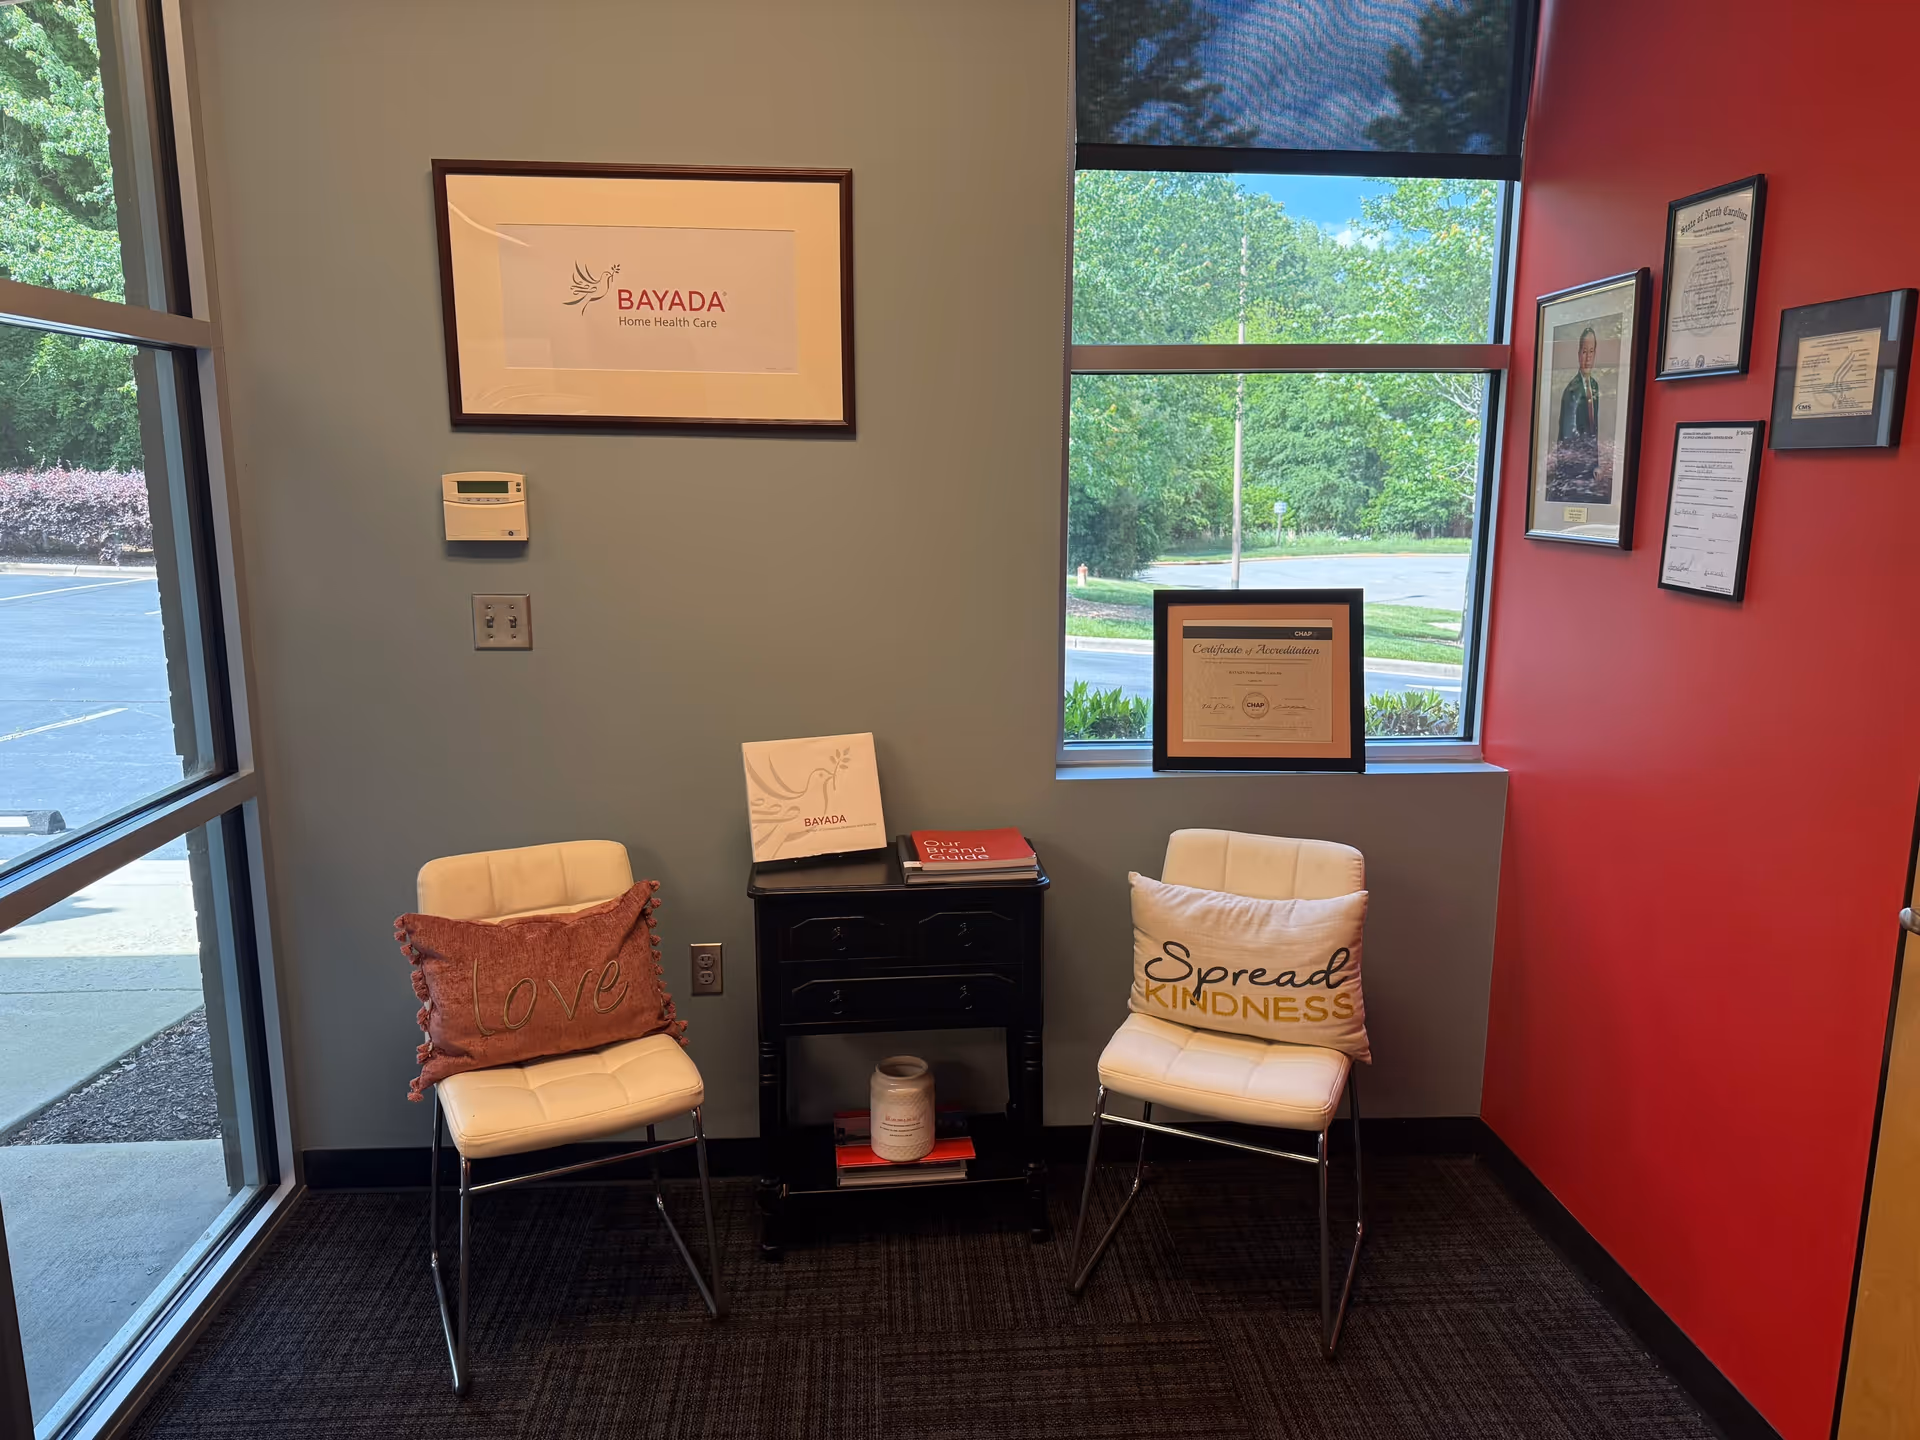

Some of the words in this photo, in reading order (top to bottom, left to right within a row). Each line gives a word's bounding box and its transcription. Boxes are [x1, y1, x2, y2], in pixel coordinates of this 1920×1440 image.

[1680, 219, 1696, 236] State
[1704, 206, 1722, 220] North
[1723, 205, 1748, 221] Carolina
[617, 289, 725, 313] BAYADA
[618, 316, 651, 327] Home
[654, 317, 690, 328] Health
[693, 318, 717, 329] Care
[1192, 643, 1243, 657] Certificate
[1245, 647, 1254, 656] of
[1256, 643, 1321, 656] Accreditation
[803, 814, 848, 827] BAYADA
[926, 846, 987, 854] Brand
[929, 853, 990, 861] Guide
[1144, 941, 1350, 1006] Spread
[1144, 978, 1354, 1023] KINDNESS
